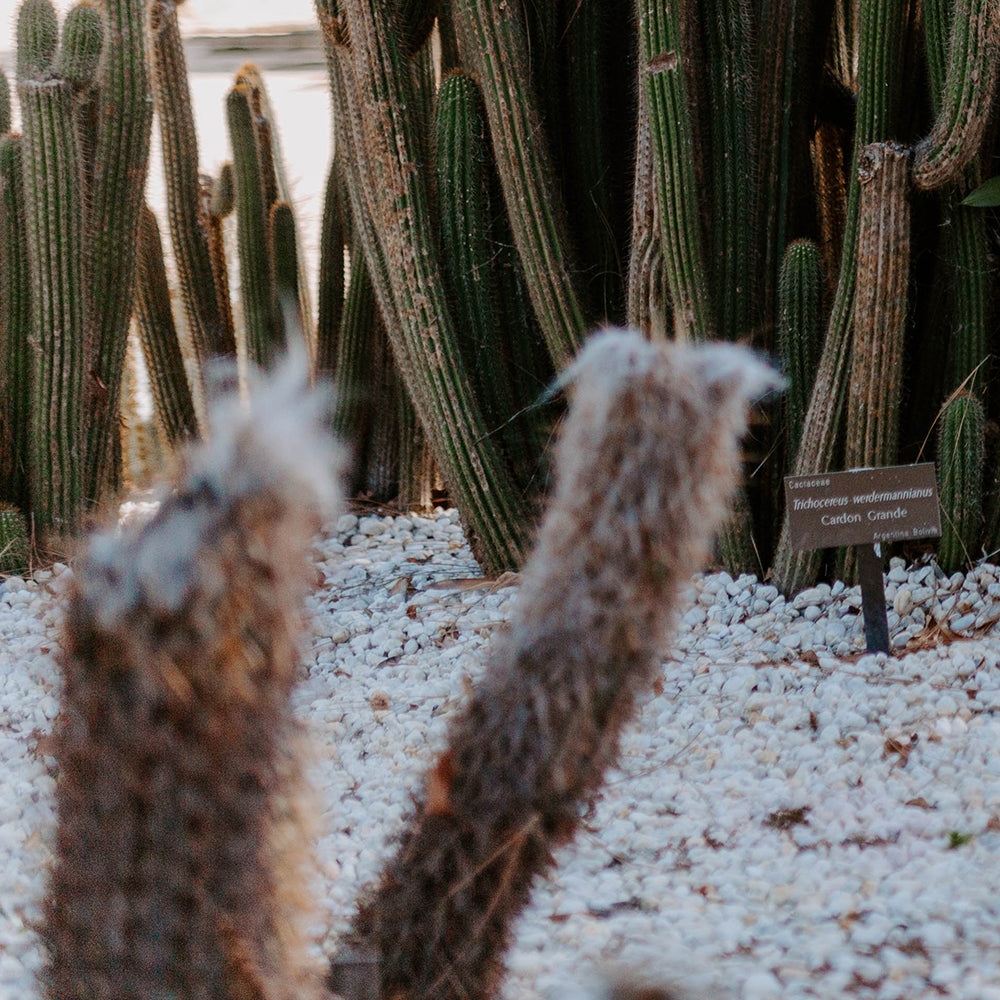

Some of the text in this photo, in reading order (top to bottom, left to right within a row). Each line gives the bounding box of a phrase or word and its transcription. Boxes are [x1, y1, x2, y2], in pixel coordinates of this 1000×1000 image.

[789, 478, 831, 490] Cactaceae
[793, 487, 933, 511] Trichocereus werdermannianus
[821, 507, 909, 526] Cardon Grande
